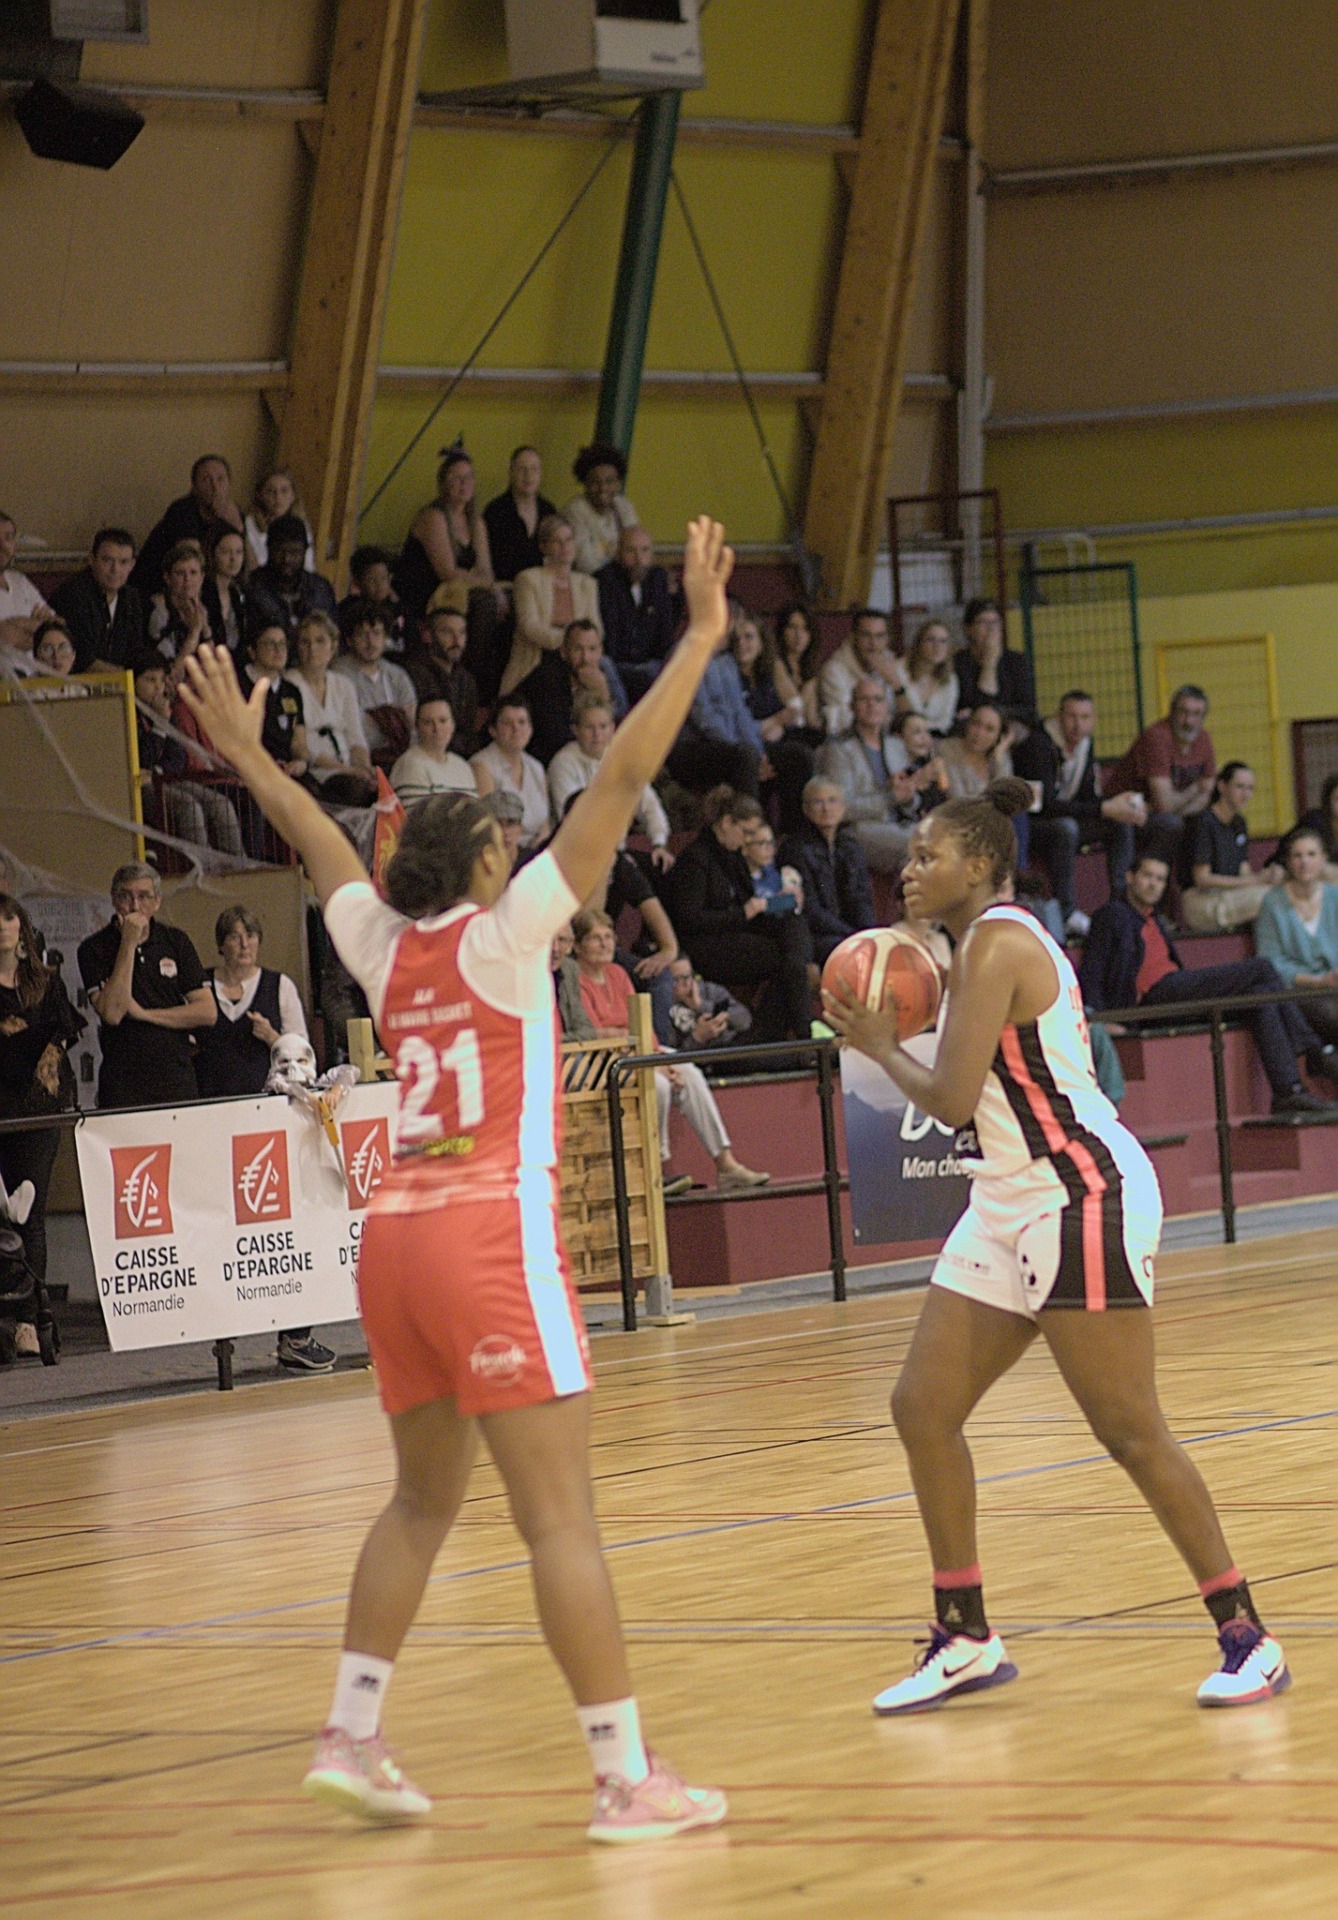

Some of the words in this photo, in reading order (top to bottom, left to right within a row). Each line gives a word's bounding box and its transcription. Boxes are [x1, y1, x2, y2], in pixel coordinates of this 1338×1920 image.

[396, 1028, 485, 1137] 21
[902, 1156, 937, 1180] Mon
[236, 1231, 296, 1256] CAISSE
[115, 1245, 179, 1271] CAISSE
[223, 1252, 314, 1282] D'EPARGNE
[101, 1267, 197, 1297] D'EPARGNE
[236, 1278, 303, 1301] Normandie
[112, 1294, 185, 1317] Normandie
